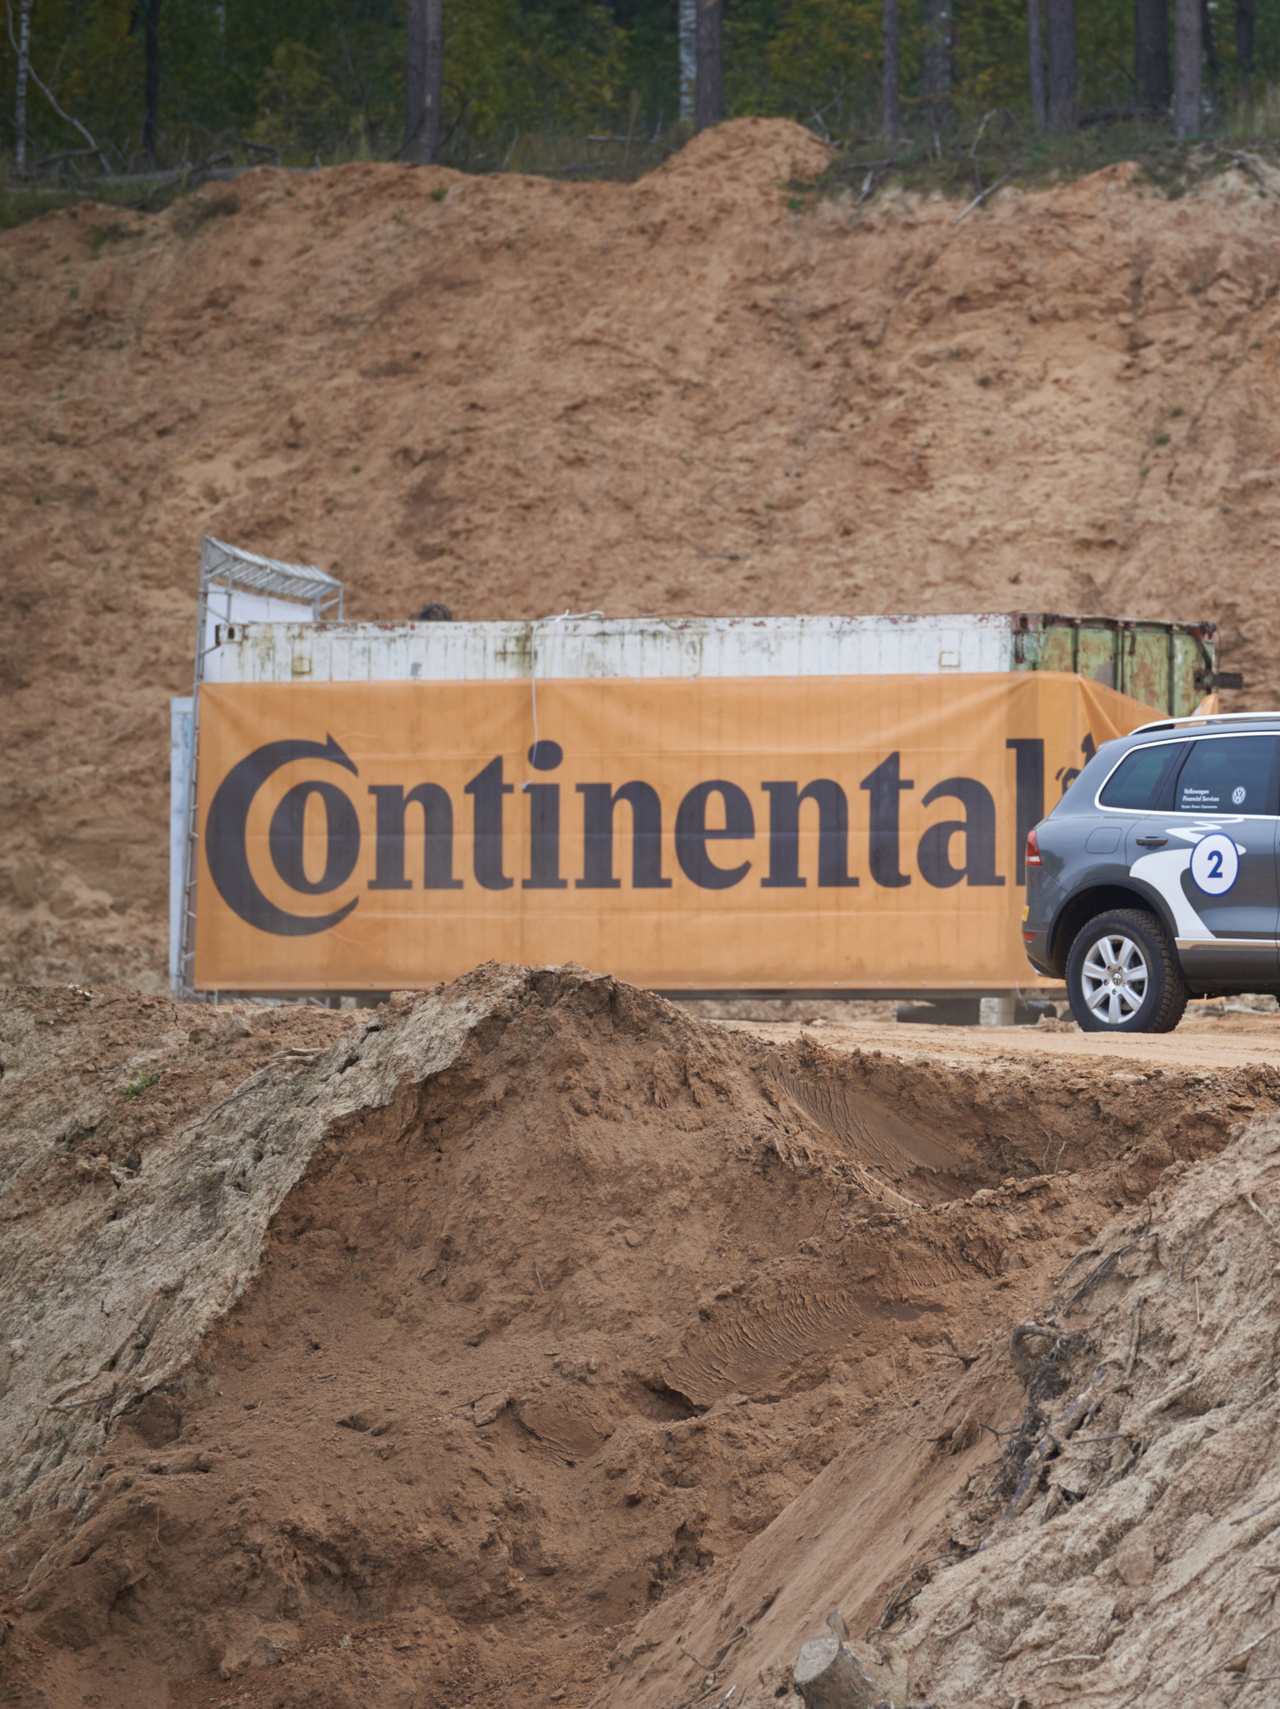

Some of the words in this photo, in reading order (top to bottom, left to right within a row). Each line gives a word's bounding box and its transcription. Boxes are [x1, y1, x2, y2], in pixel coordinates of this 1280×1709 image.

[1183, 787, 1210, 796] Volkswagen
[205, 732, 1044, 936] Continental
[1207, 849, 1223, 879] 2
